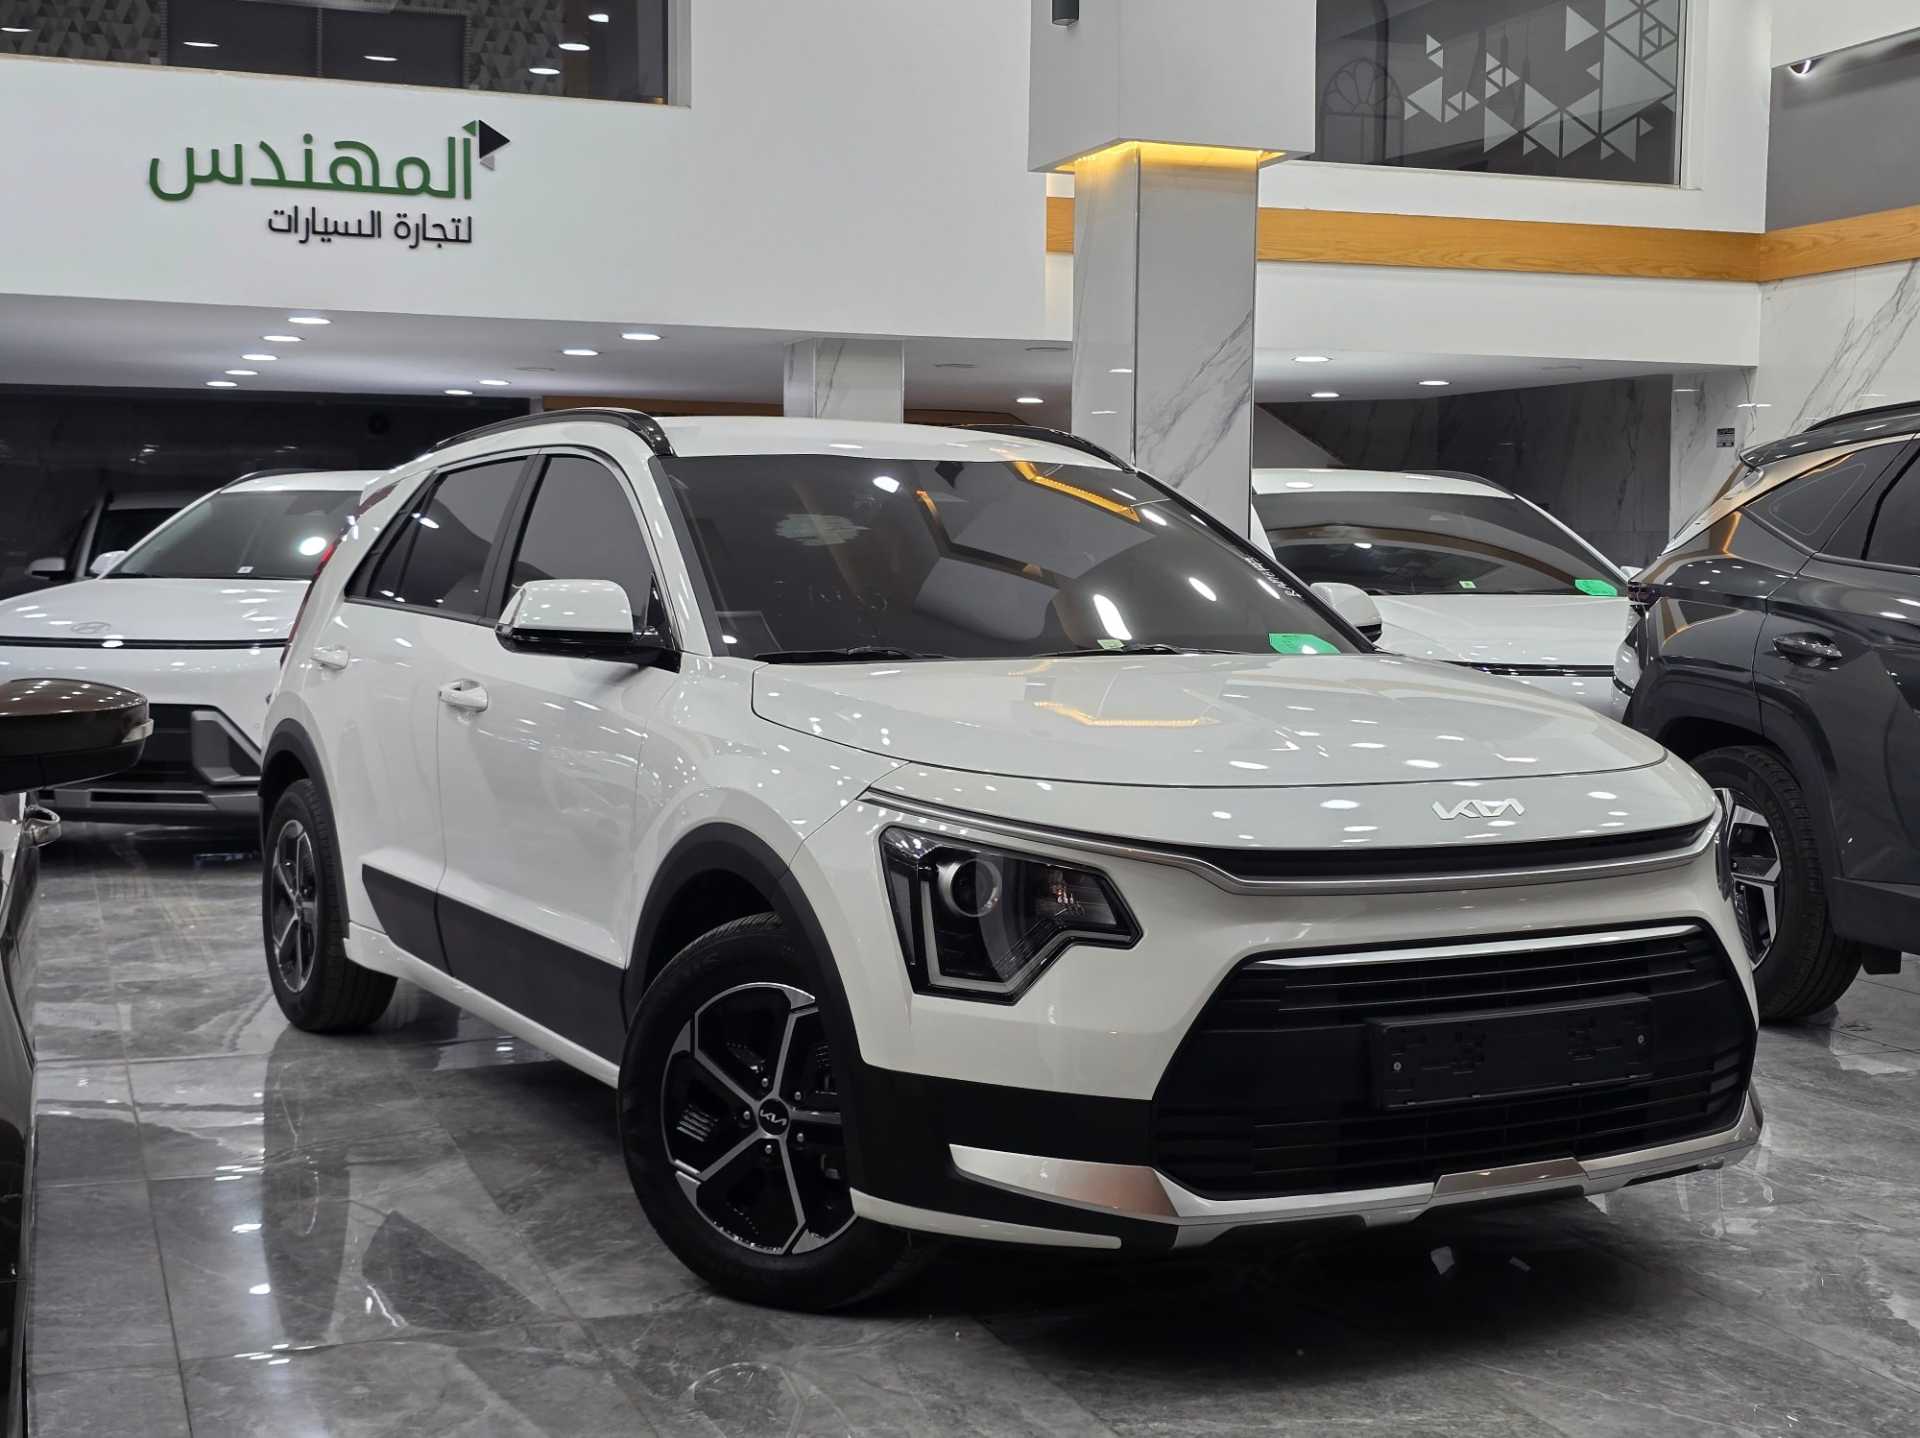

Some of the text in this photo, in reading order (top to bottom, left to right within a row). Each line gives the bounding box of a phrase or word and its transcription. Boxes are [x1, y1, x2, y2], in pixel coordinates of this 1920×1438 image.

[148, 132, 473, 201] المهندس
[267, 205, 473, 249] لتجارة السيارات
[1432, 798, 1525, 820] KIA
